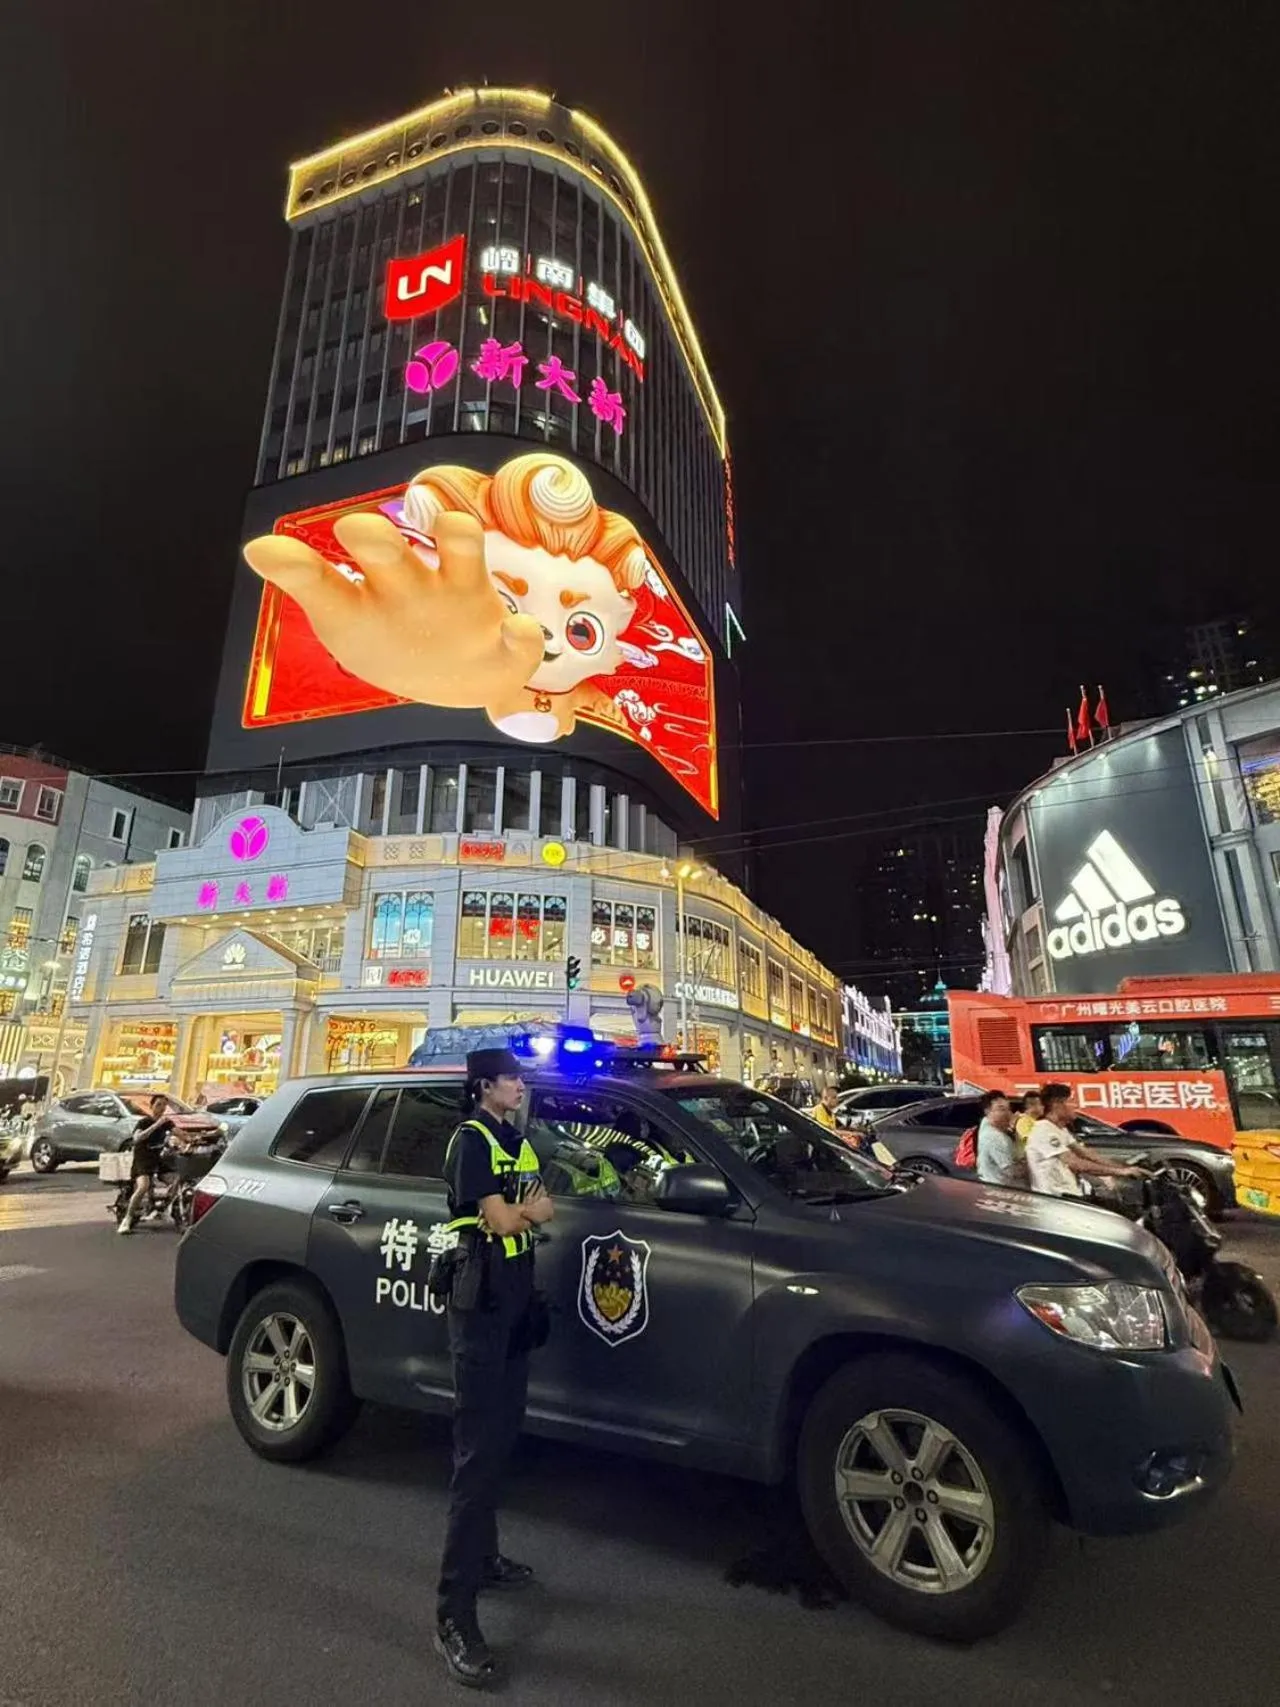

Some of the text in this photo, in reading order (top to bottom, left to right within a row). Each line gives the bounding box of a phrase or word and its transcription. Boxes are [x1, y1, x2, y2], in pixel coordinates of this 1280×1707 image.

[481, 272, 645, 384] LINGNAN
[471, 337, 627, 435] 新大新
[1047, 898, 1185, 959] adidas
[469, 968, 554, 988] HUAWEI
[1013, 1080, 1219, 1111] 口腔医院
[375, 1277, 446, 1315] POLIC
